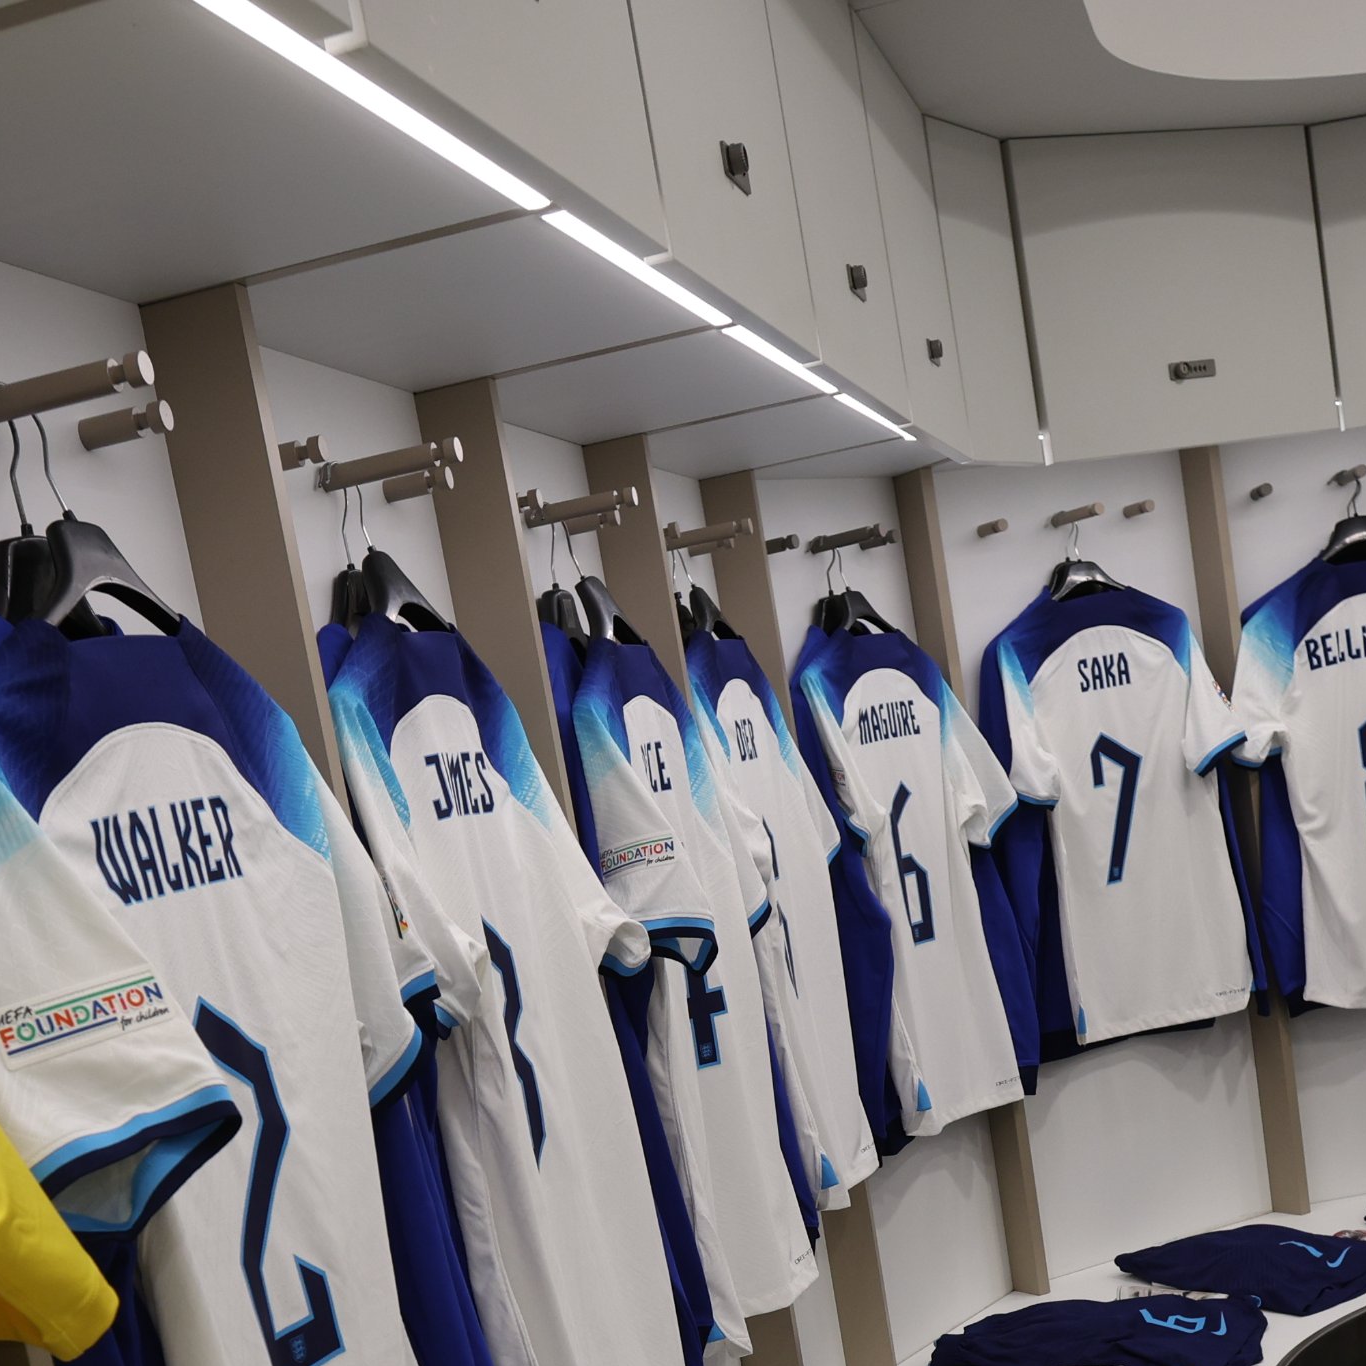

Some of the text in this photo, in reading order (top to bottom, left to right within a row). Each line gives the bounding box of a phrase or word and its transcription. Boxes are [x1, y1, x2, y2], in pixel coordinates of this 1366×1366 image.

[1077, 652, 1131, 693] SAKA
[1089, 731, 1143, 887] 7
[90, 795, 244, 906] WALKER
[890, 780, 936, 946] 6
[121, 1007, 169, 1031] for children
[1138, 1308, 1206, 1334] 6
